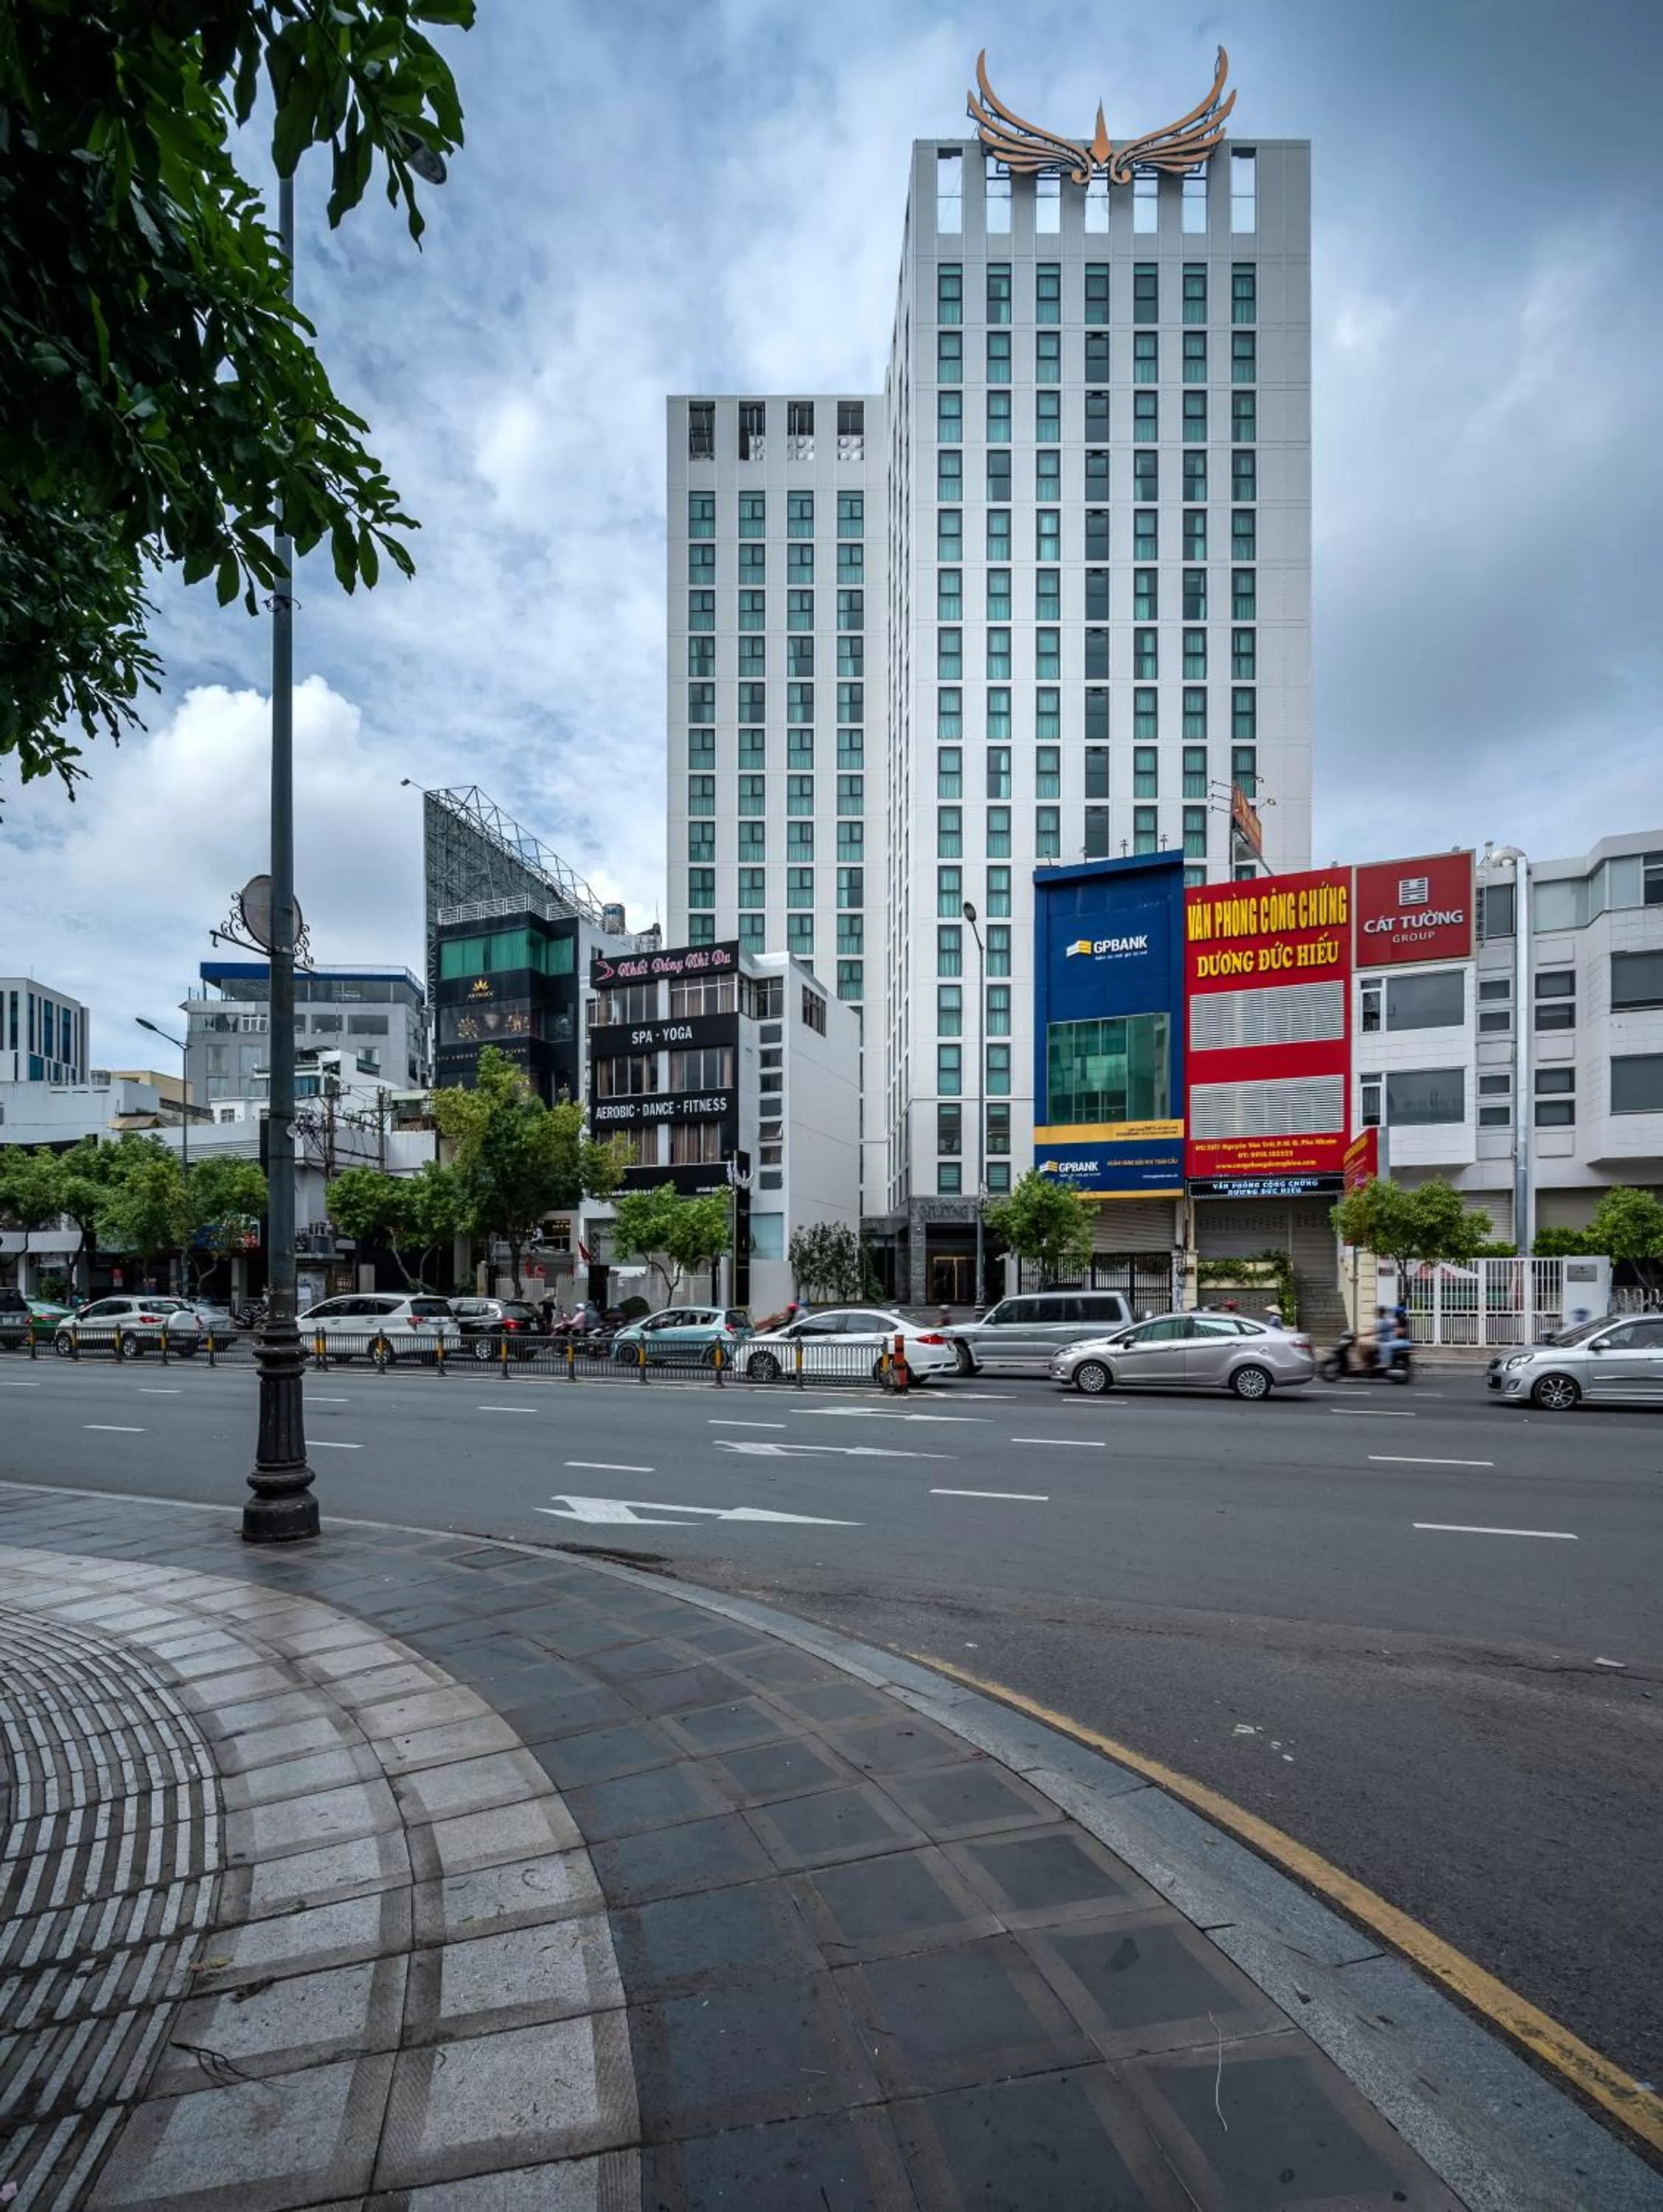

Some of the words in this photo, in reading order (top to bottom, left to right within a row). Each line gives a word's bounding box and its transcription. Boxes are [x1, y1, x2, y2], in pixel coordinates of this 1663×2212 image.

[1188, 898, 1211, 941] VĂN
[1215, 894, 1257, 938] PHÒNG
[1260, 888, 1295, 933] CÔNG
[1299, 882, 1347, 928] CHỨNG
[1364, 916, 1396, 933] CÁT
[1401, 909, 1463, 929] TƯỜNG
[1093, 935, 1148, 953] GPBANK
[1392, 931, 1435, 943] GROUP
[1197, 948, 1255, 977] DƯƠNG
[1258, 941, 1293, 970] ĐỨC
[1297, 932, 1339, 966] HIẾU
[632, 1030, 653, 1044] SPA
[663, 1026, 693, 1041] YOGA
[596, 1104, 635, 1119] AEROBIC
[642, 1102, 674, 1116] DANCE
[683, 1097, 727, 1113] FITNESS
[1059, 1161, 1098, 1172] GPBANK
